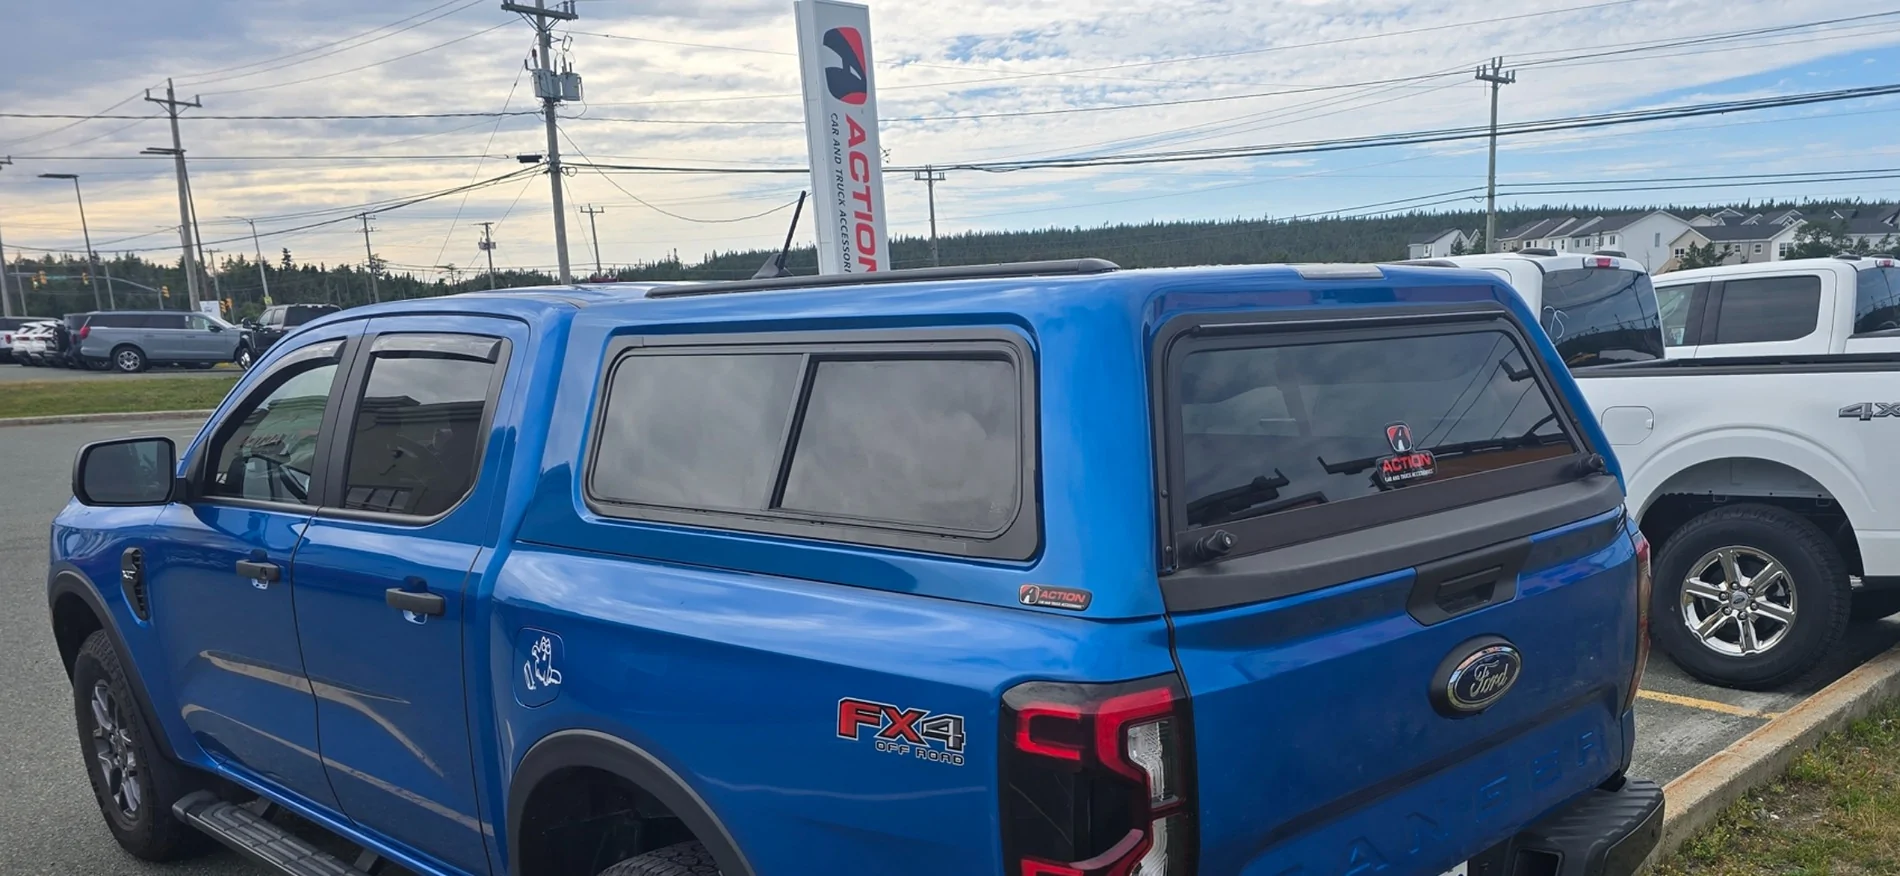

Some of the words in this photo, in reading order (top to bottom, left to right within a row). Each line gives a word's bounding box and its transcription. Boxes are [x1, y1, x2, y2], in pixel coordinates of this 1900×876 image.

[830, 112, 840, 136] CAR
[833, 138, 842, 165] AND
[835, 169, 846, 207] TRUCK
[1382, 453, 1431, 473] ACTION
[1039, 590, 1086, 603] ACTION
[1469, 659, 1509, 698] Ford
[836, 696, 967, 754] FX4
[875, 740, 910, 755] OFF
[915, 747, 965, 767] ROAD
